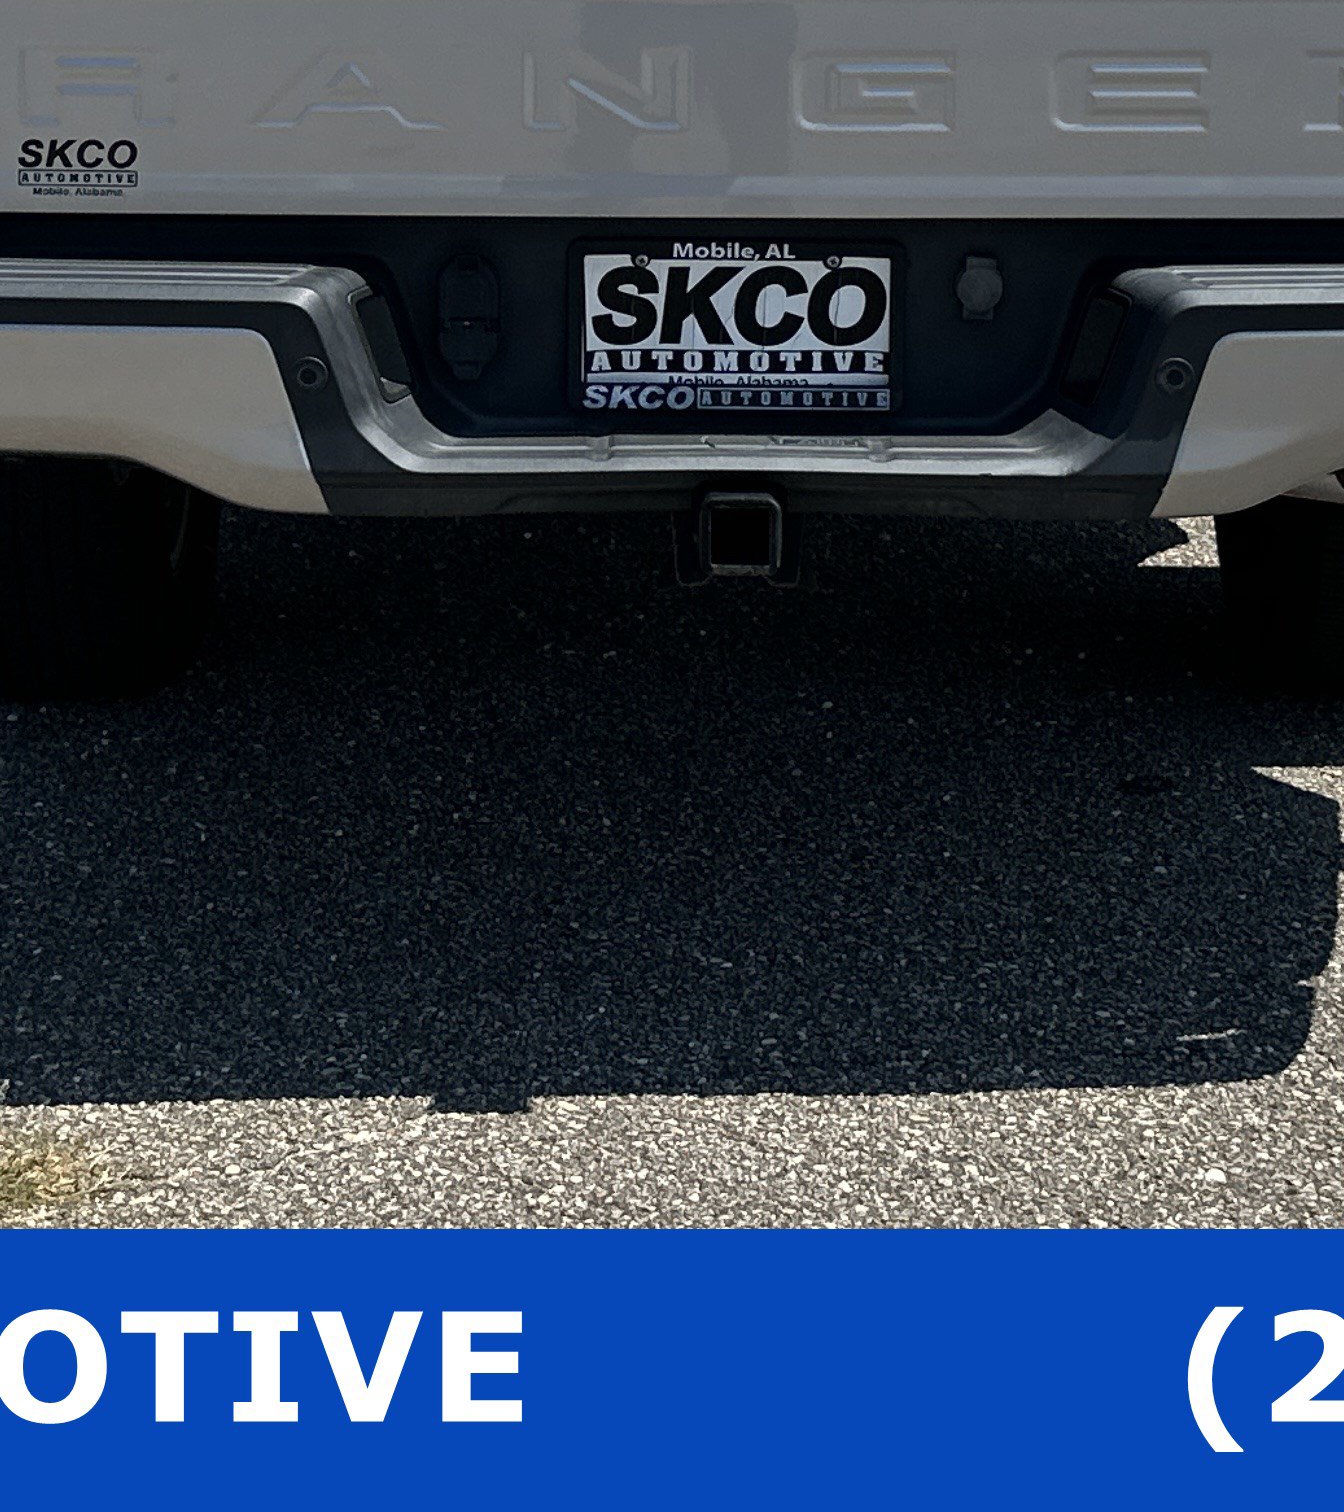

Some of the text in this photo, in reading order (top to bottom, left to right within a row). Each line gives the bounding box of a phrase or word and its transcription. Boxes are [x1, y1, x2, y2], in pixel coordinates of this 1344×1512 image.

[17, 138, 139, 169] SKCO
[21, 172, 135, 184] AUTOMOTIVE
[672, 242, 796, 260] Mobile, AL
[591, 265, 888, 347] SKCO
[591, 350, 884, 372] AUTOMOTIVE
[582, 385, 889, 410] SKCO AUTOMOTIVE
